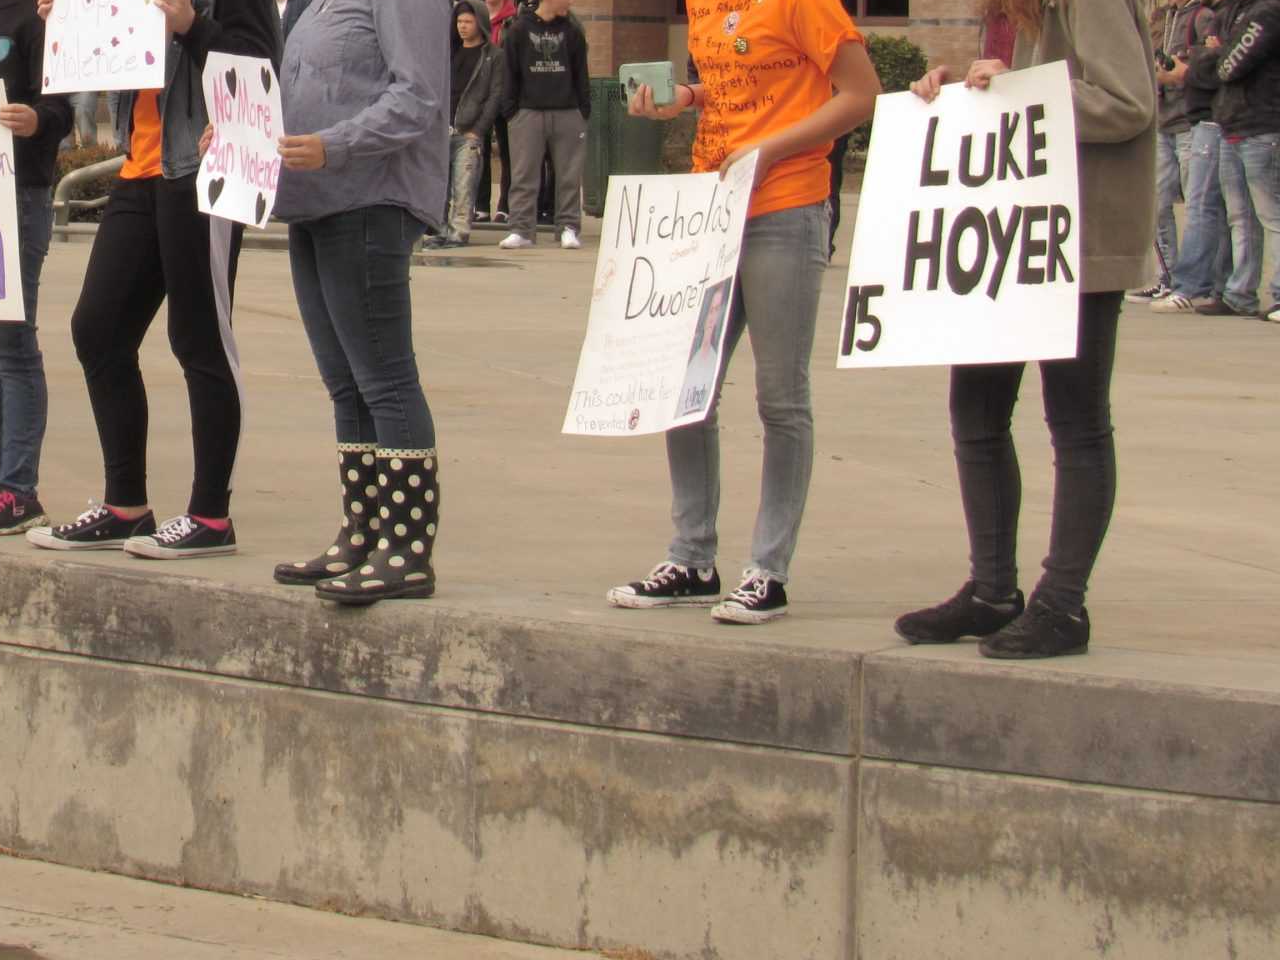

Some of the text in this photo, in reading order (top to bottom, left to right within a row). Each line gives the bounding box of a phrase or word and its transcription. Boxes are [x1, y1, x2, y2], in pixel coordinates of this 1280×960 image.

[213, 71, 272, 138] No More
[920, 104, 1047, 188] LUKE
[615, 183, 733, 248] Nicholas
[902, 204, 1074, 301] HOYER
[624, 256, 710, 320] Dworet
[841, 284, 884, 356] 15
